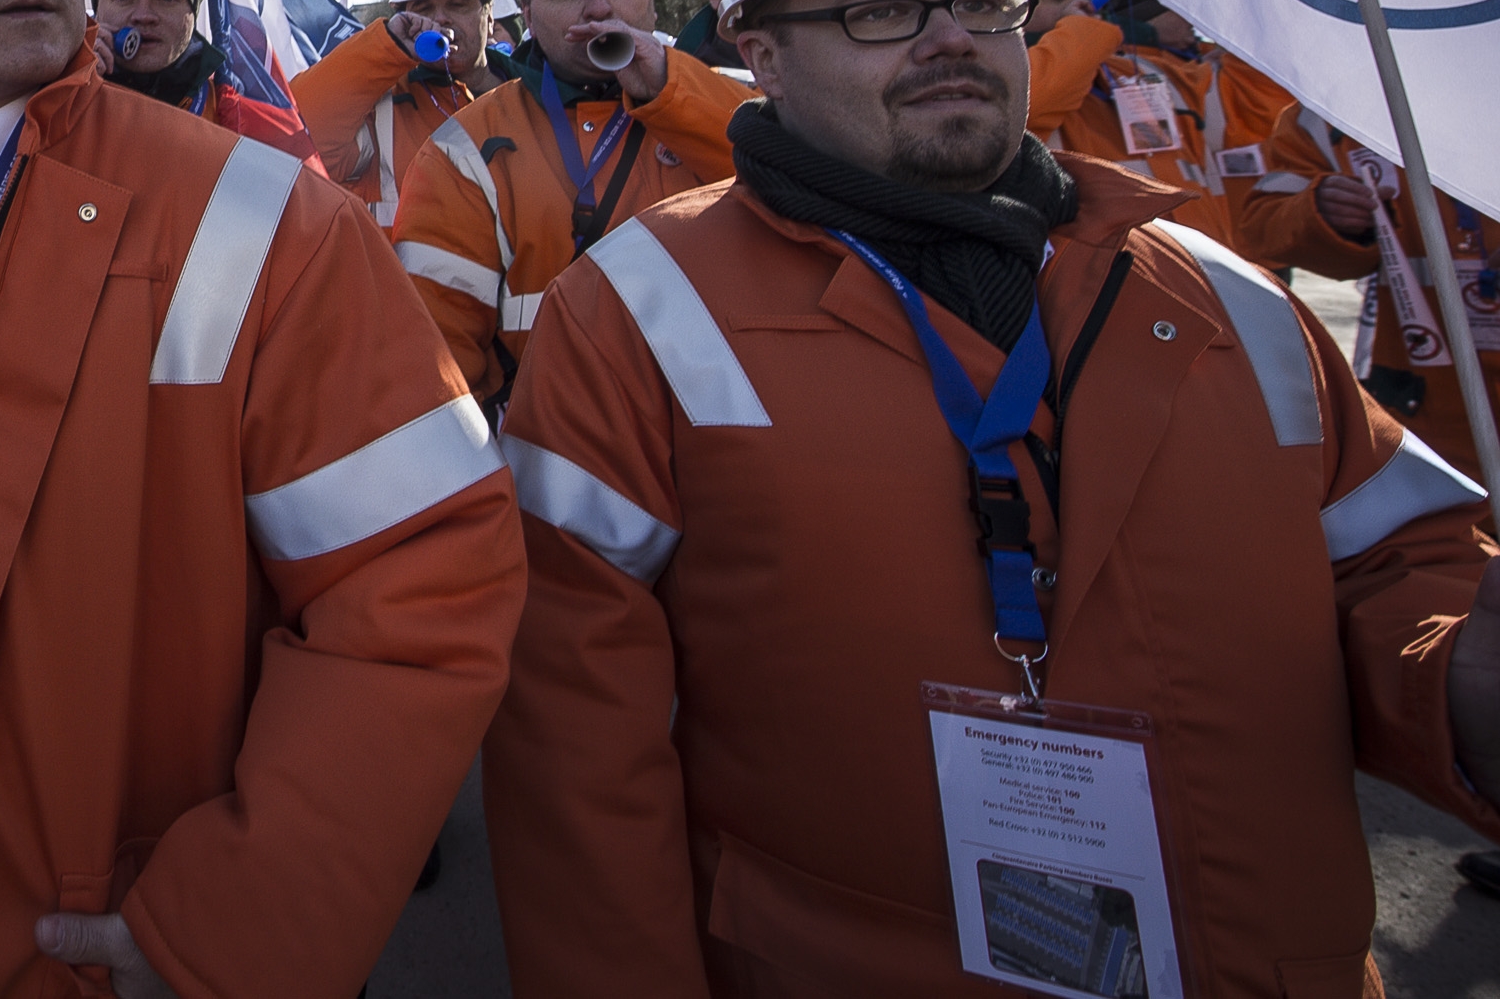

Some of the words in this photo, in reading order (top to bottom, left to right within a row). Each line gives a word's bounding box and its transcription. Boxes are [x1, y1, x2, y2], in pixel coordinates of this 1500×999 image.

[964, 726, 1039, 751] Emergency
[1041, 741, 1104, 760] numbers
[999, 777, 1030, 790] Medical
[988, 817, 1004, 829] Red
